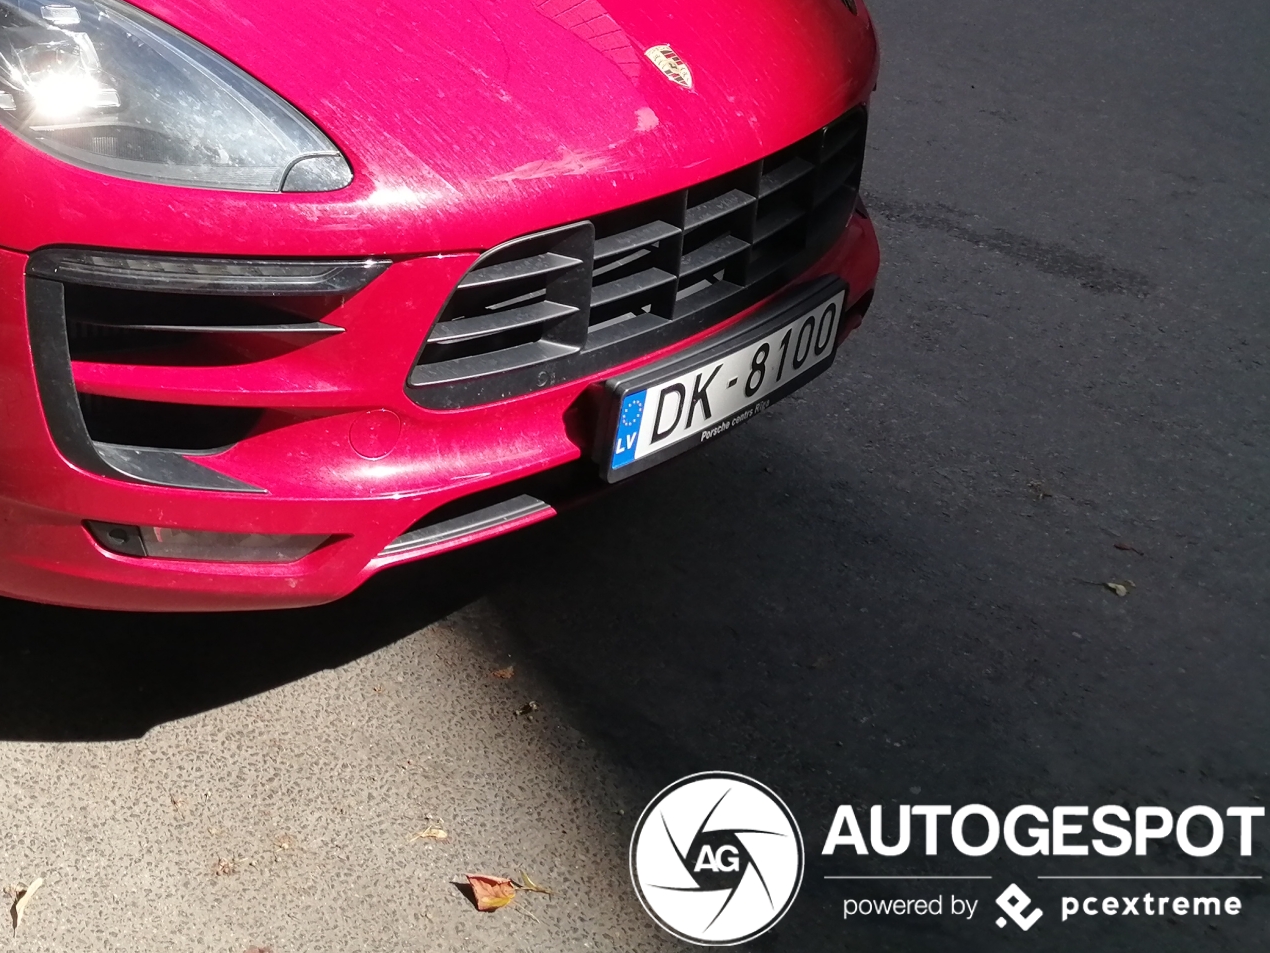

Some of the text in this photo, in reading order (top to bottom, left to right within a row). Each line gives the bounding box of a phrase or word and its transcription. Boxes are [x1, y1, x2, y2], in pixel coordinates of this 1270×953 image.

[649, 301, 837, 446] DK-8100
[700, 421, 731, 442] Porsche
[731, 408, 754, 427] centrs
[615, 431, 637, 455] LV
